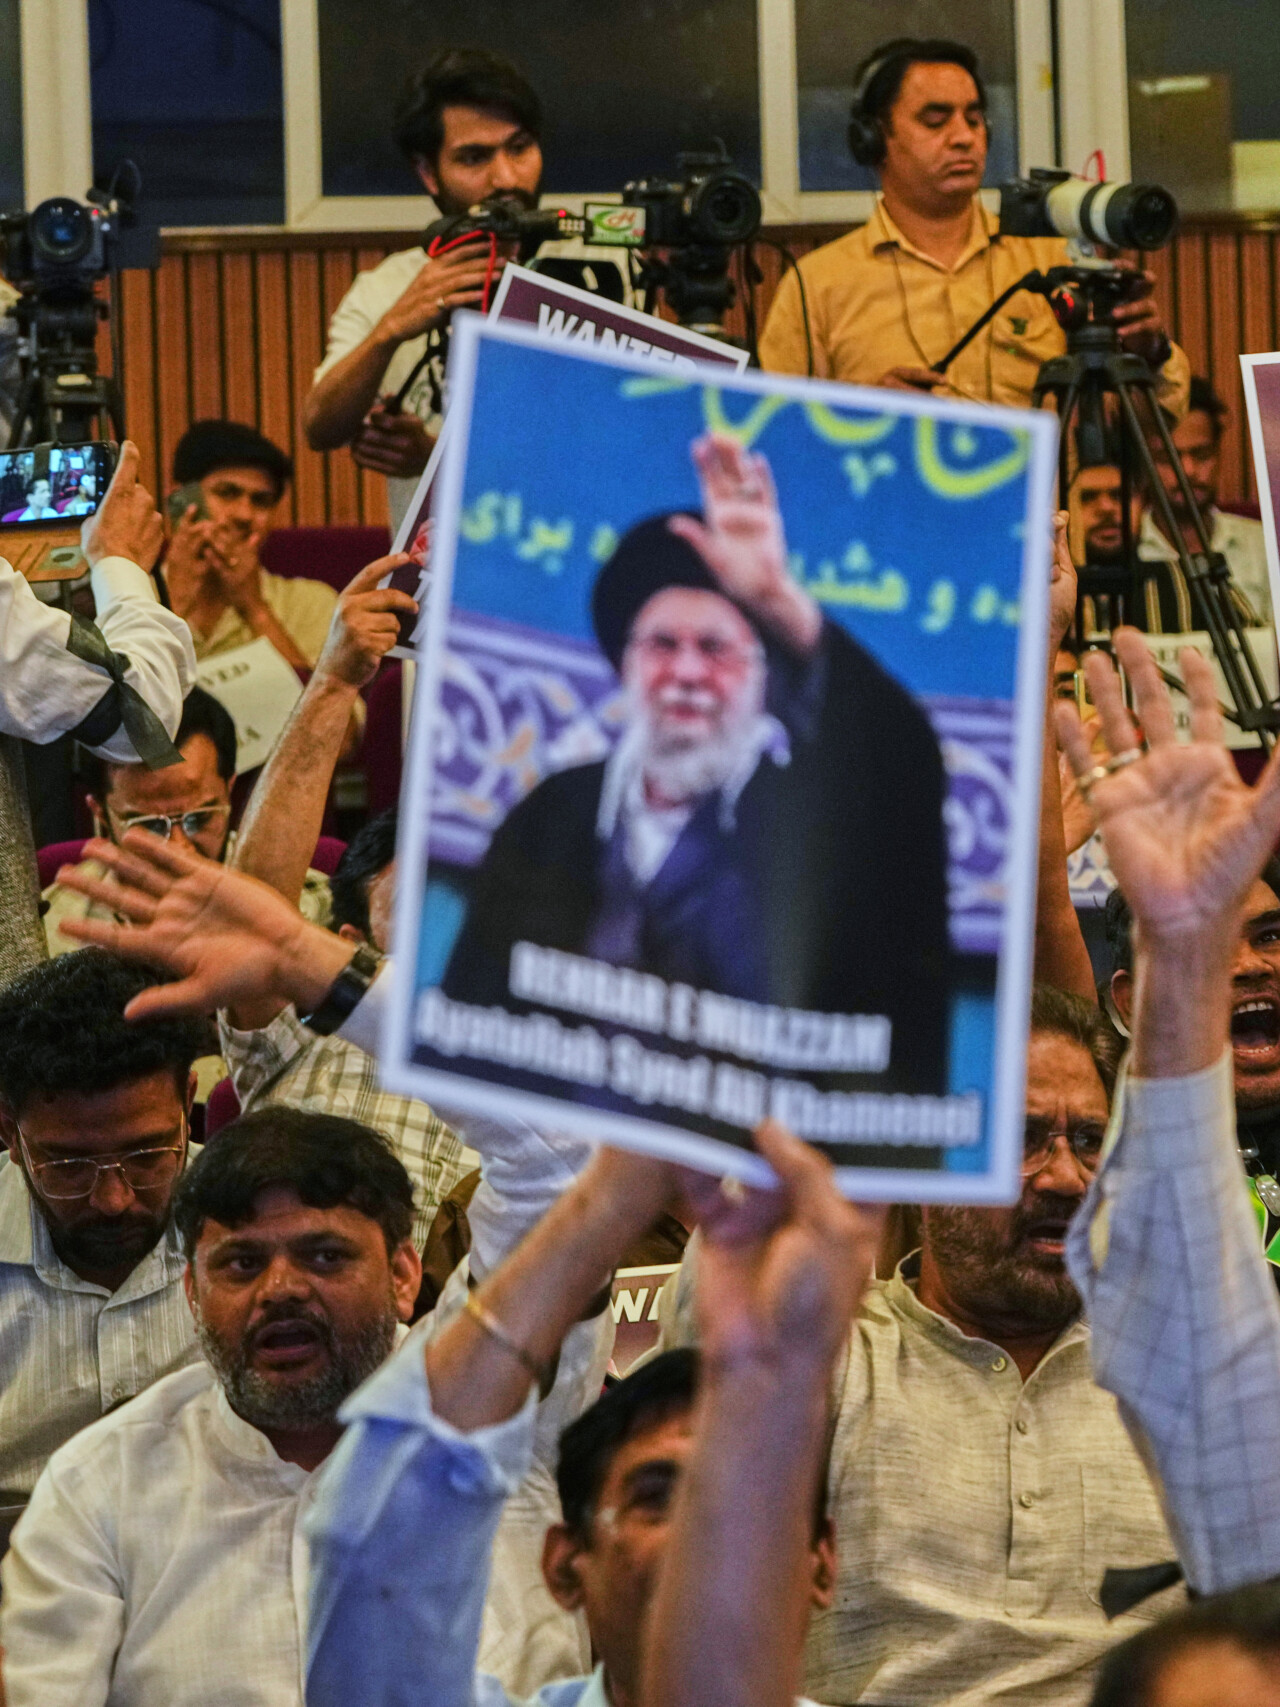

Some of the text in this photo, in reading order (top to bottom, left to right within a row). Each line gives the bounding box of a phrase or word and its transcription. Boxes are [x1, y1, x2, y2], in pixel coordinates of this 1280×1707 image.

[509, 941, 891, 1073] REHBAR E MUAZZAM
